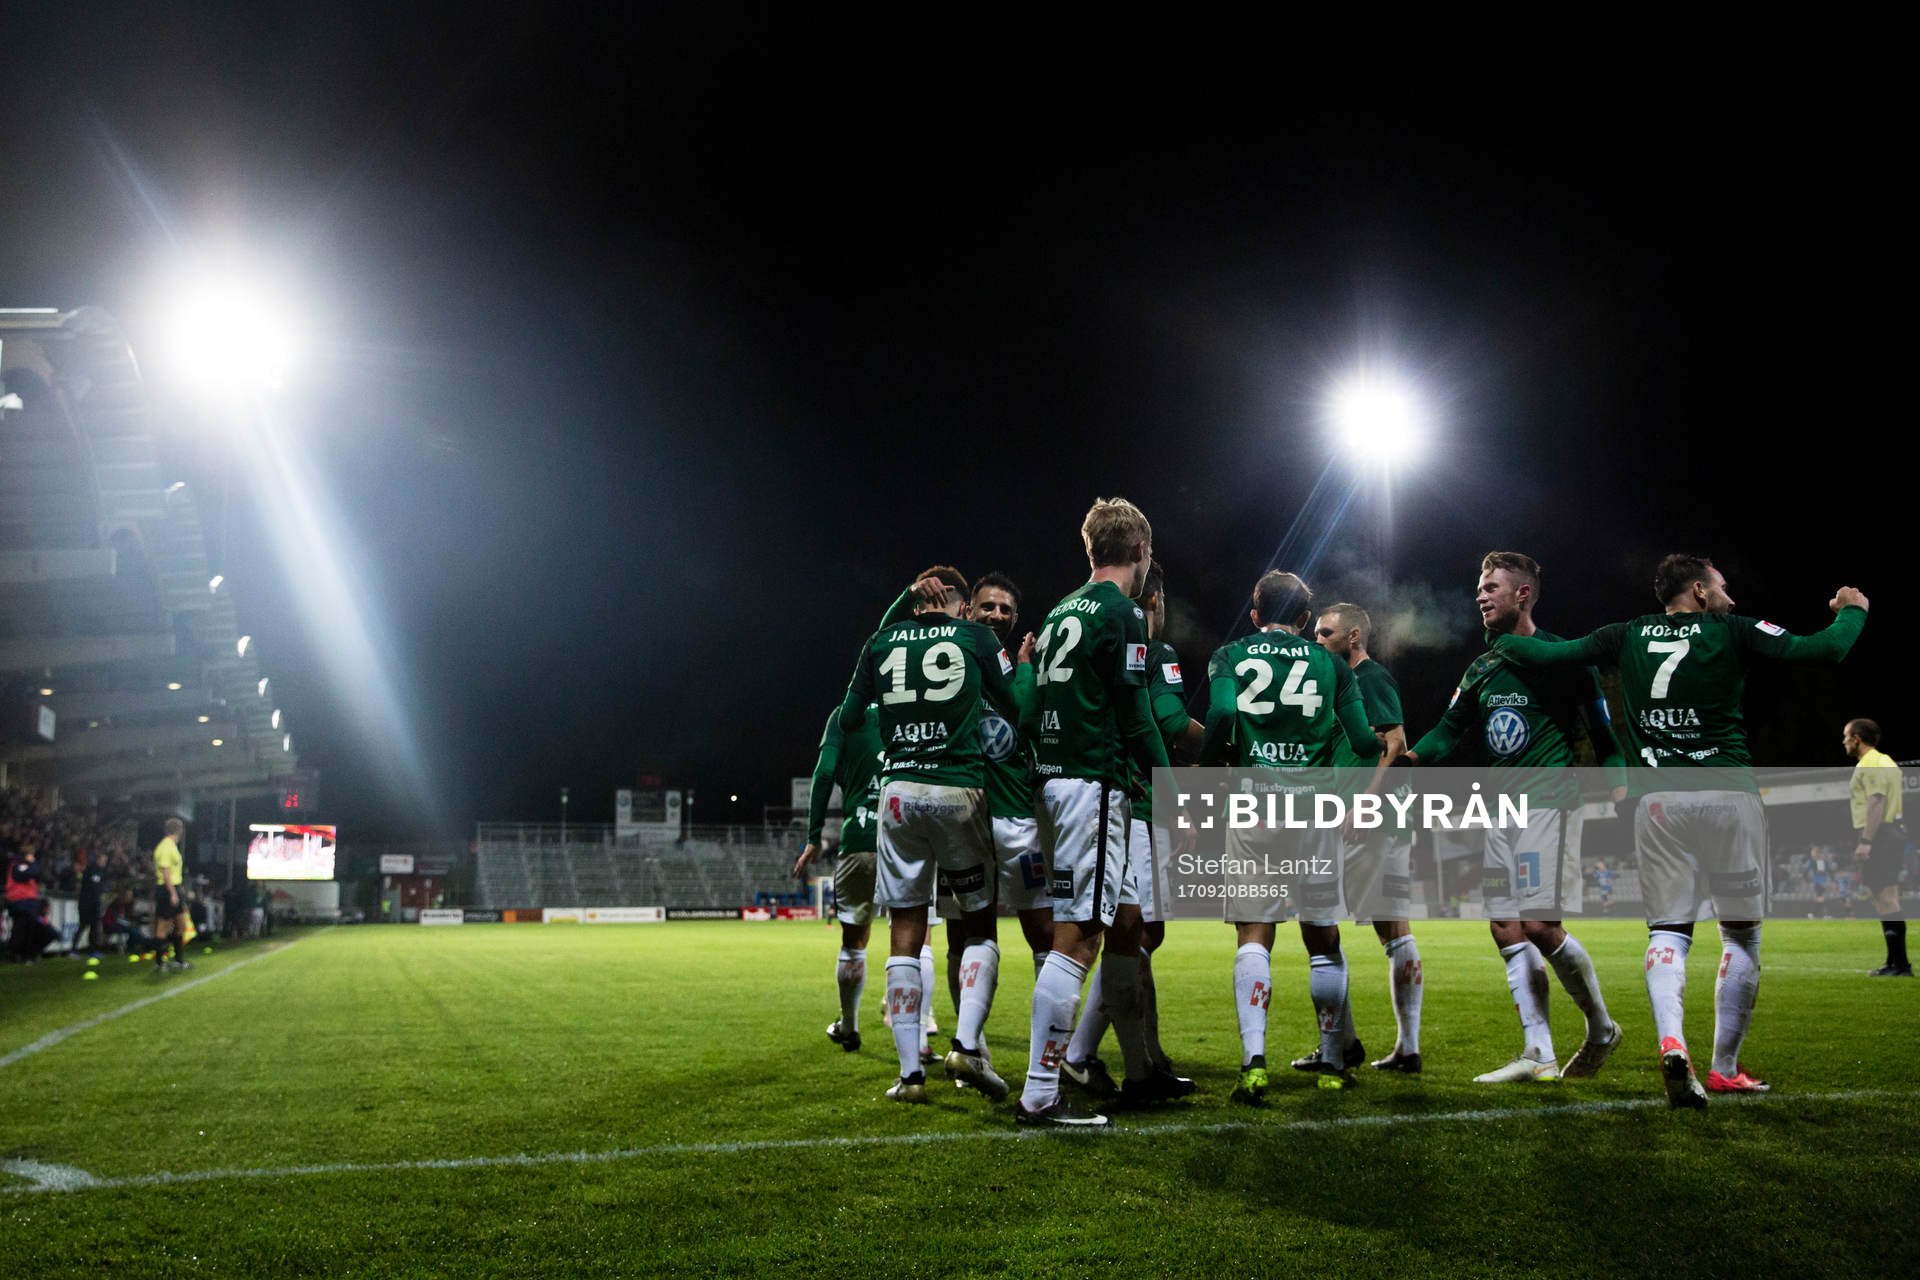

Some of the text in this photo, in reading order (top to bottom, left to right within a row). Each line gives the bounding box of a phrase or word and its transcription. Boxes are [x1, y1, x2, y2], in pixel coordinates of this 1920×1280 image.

[889, 626, 957, 642] JALLOW
[1035, 616, 1082, 686] 12
[1247, 643, 1310, 657] GOJANI
[878, 641, 966, 705] 19
[1648, 639, 1690, 699] 7
[1235, 658, 1323, 717] 24
[1640, 708, 1701, 729] AQUA
[892, 722, 949, 743] AQUA
[1249, 740, 1309, 762] AQUA
[1102, 903, 1116, 917] 12
